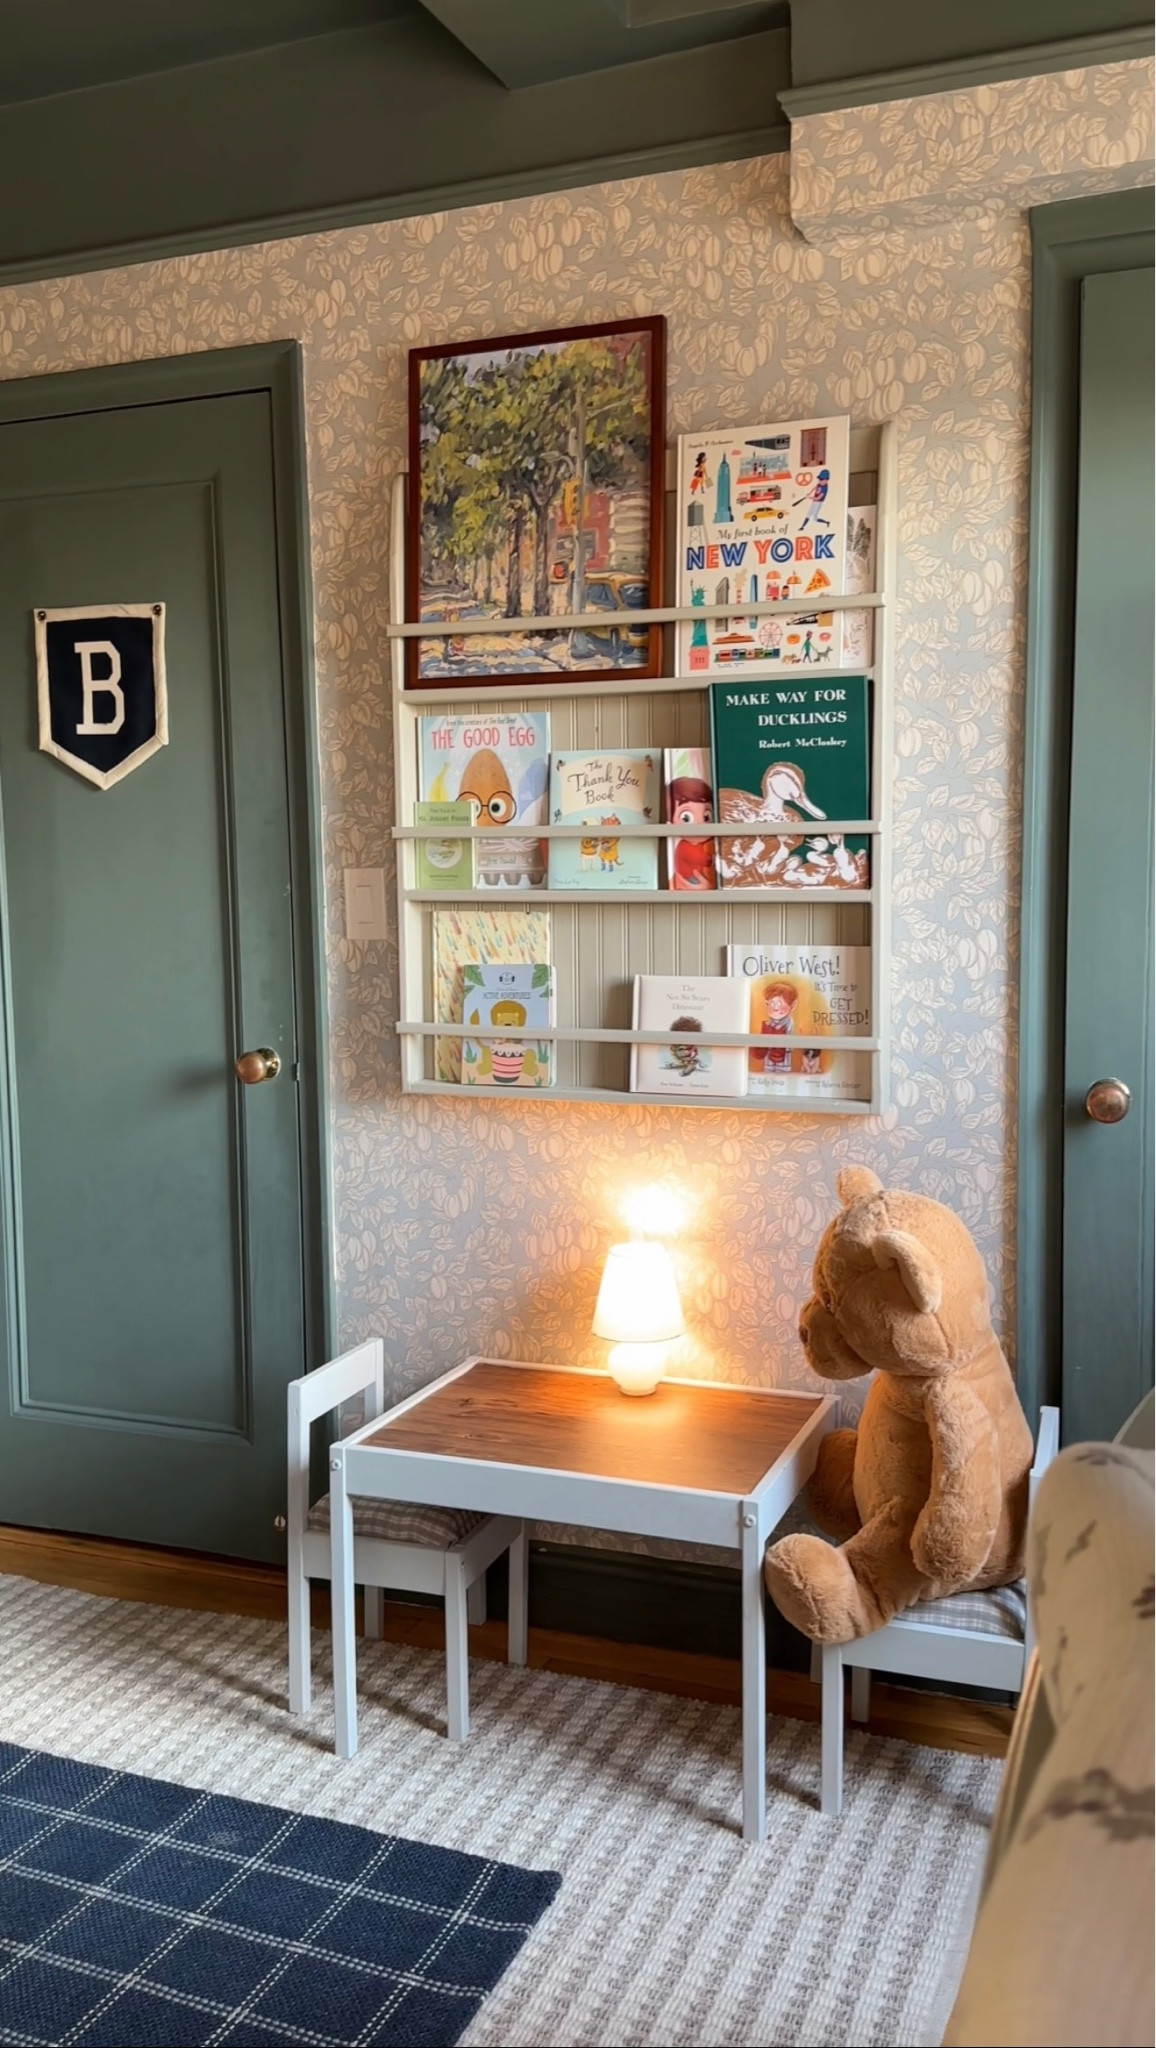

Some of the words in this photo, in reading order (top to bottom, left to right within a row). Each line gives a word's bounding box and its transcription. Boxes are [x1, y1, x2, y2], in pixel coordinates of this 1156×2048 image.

[716, 529, 731, 540] My
[733, 527, 753, 539] first
[754, 525, 776, 536] book
[778, 524, 789, 535] of
[686, 541, 748, 570] NEW
[753, 534, 835, 564] YORK
[74, 641, 125, 735] B
[726, 693, 770, 706] MAKE
[776, 691, 807, 703] WAY
[814, 689, 847, 702] FOR
[758, 711, 847, 726] DUCKLINGS
[431, 728, 455, 750] THE
[463, 727, 500, 748] GOOD
[508, 726, 536, 747] EGG
[758, 739, 791, 749] Robert
[795, 737, 847, 748] McCloskey
[585, 759, 602, 771] The
[567, 762, 613, 792] Thank
[615, 766, 640, 789] You
[584, 785, 615, 805] Book
[742, 955, 793, 976] Oliver
[799, 955, 840, 978] West!
[829, 982, 849, 992] Time
[829, 998, 853, 1011] GET
[812, 1010, 869, 1026] DRESSED!
